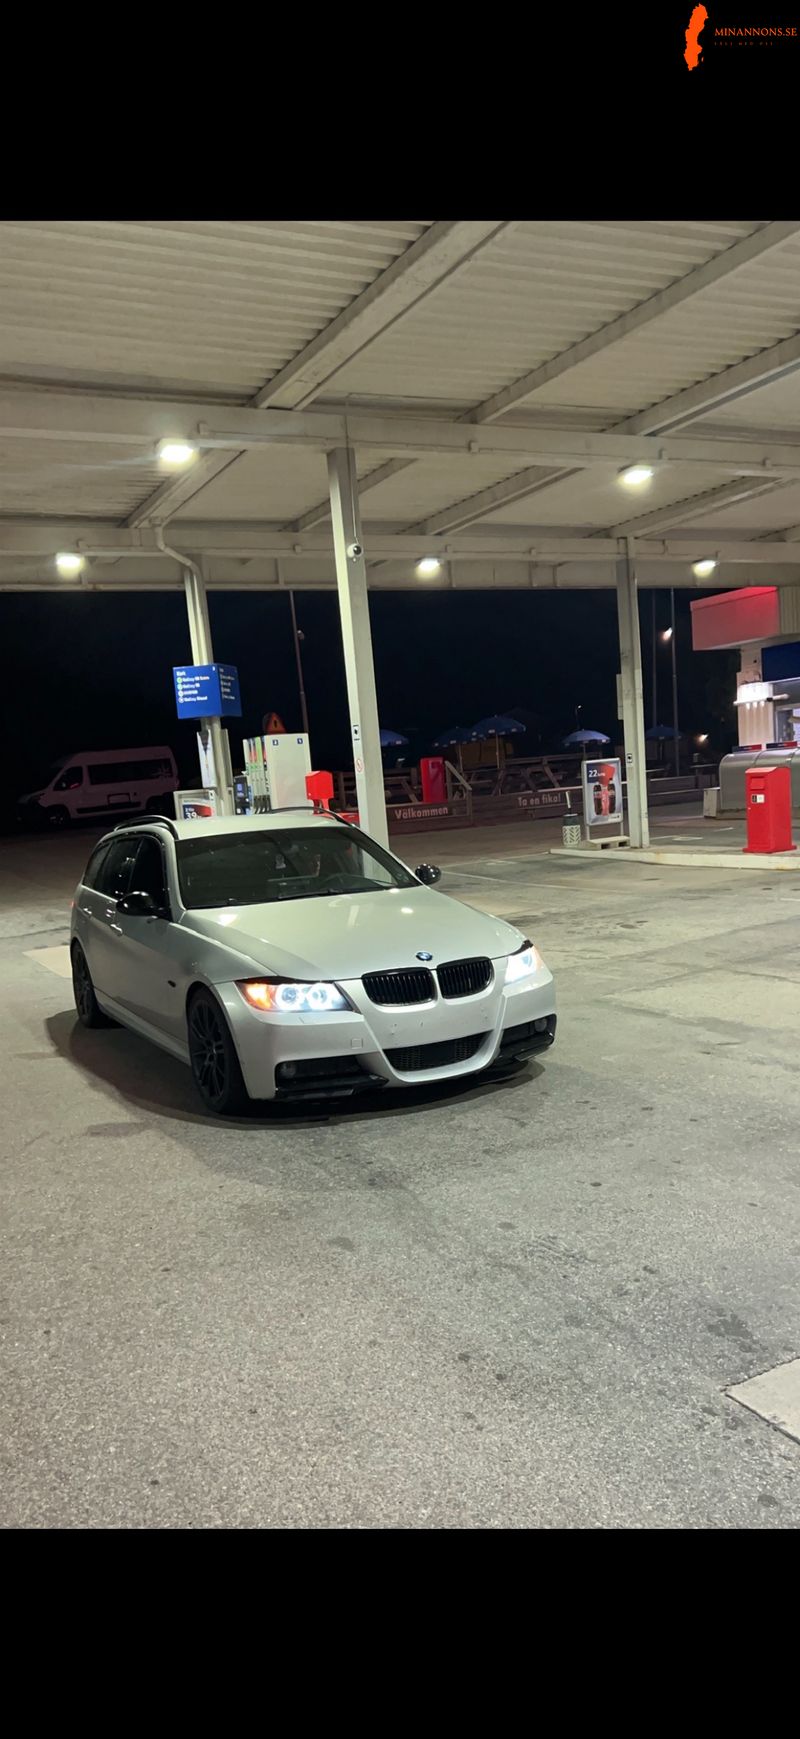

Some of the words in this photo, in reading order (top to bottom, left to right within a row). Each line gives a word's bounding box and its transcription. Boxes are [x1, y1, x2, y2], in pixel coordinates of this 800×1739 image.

[588, 769, 598, 778] 22
[517, 795, 528, 807] Ta
[529, 796, 541, 806] en
[541, 792, 562, 805] fika!
[394, 805, 449, 820] Välkommen
